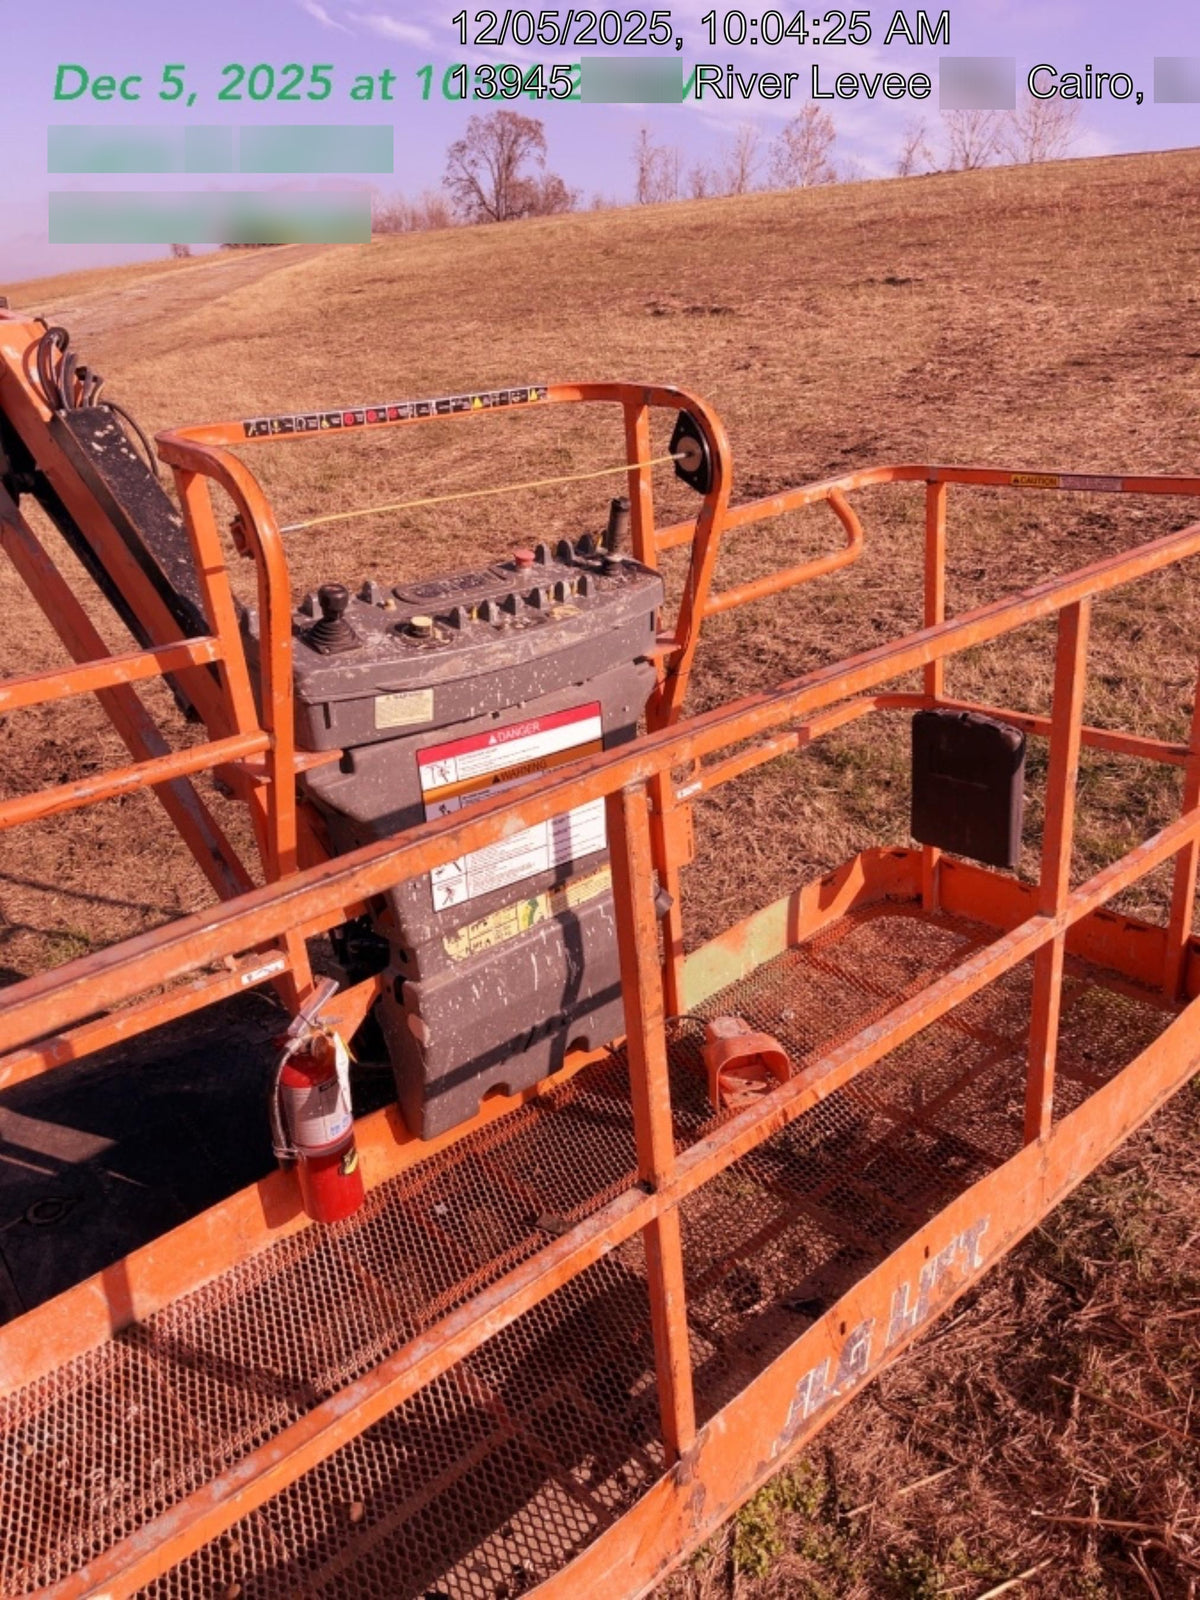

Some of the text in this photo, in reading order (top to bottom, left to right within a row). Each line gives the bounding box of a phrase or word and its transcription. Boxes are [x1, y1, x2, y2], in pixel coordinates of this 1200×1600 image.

[1019, 475, 1058, 487] CAUTION
[497, 720, 541, 743] DANGER
[500, 758, 548, 782] WARNING
